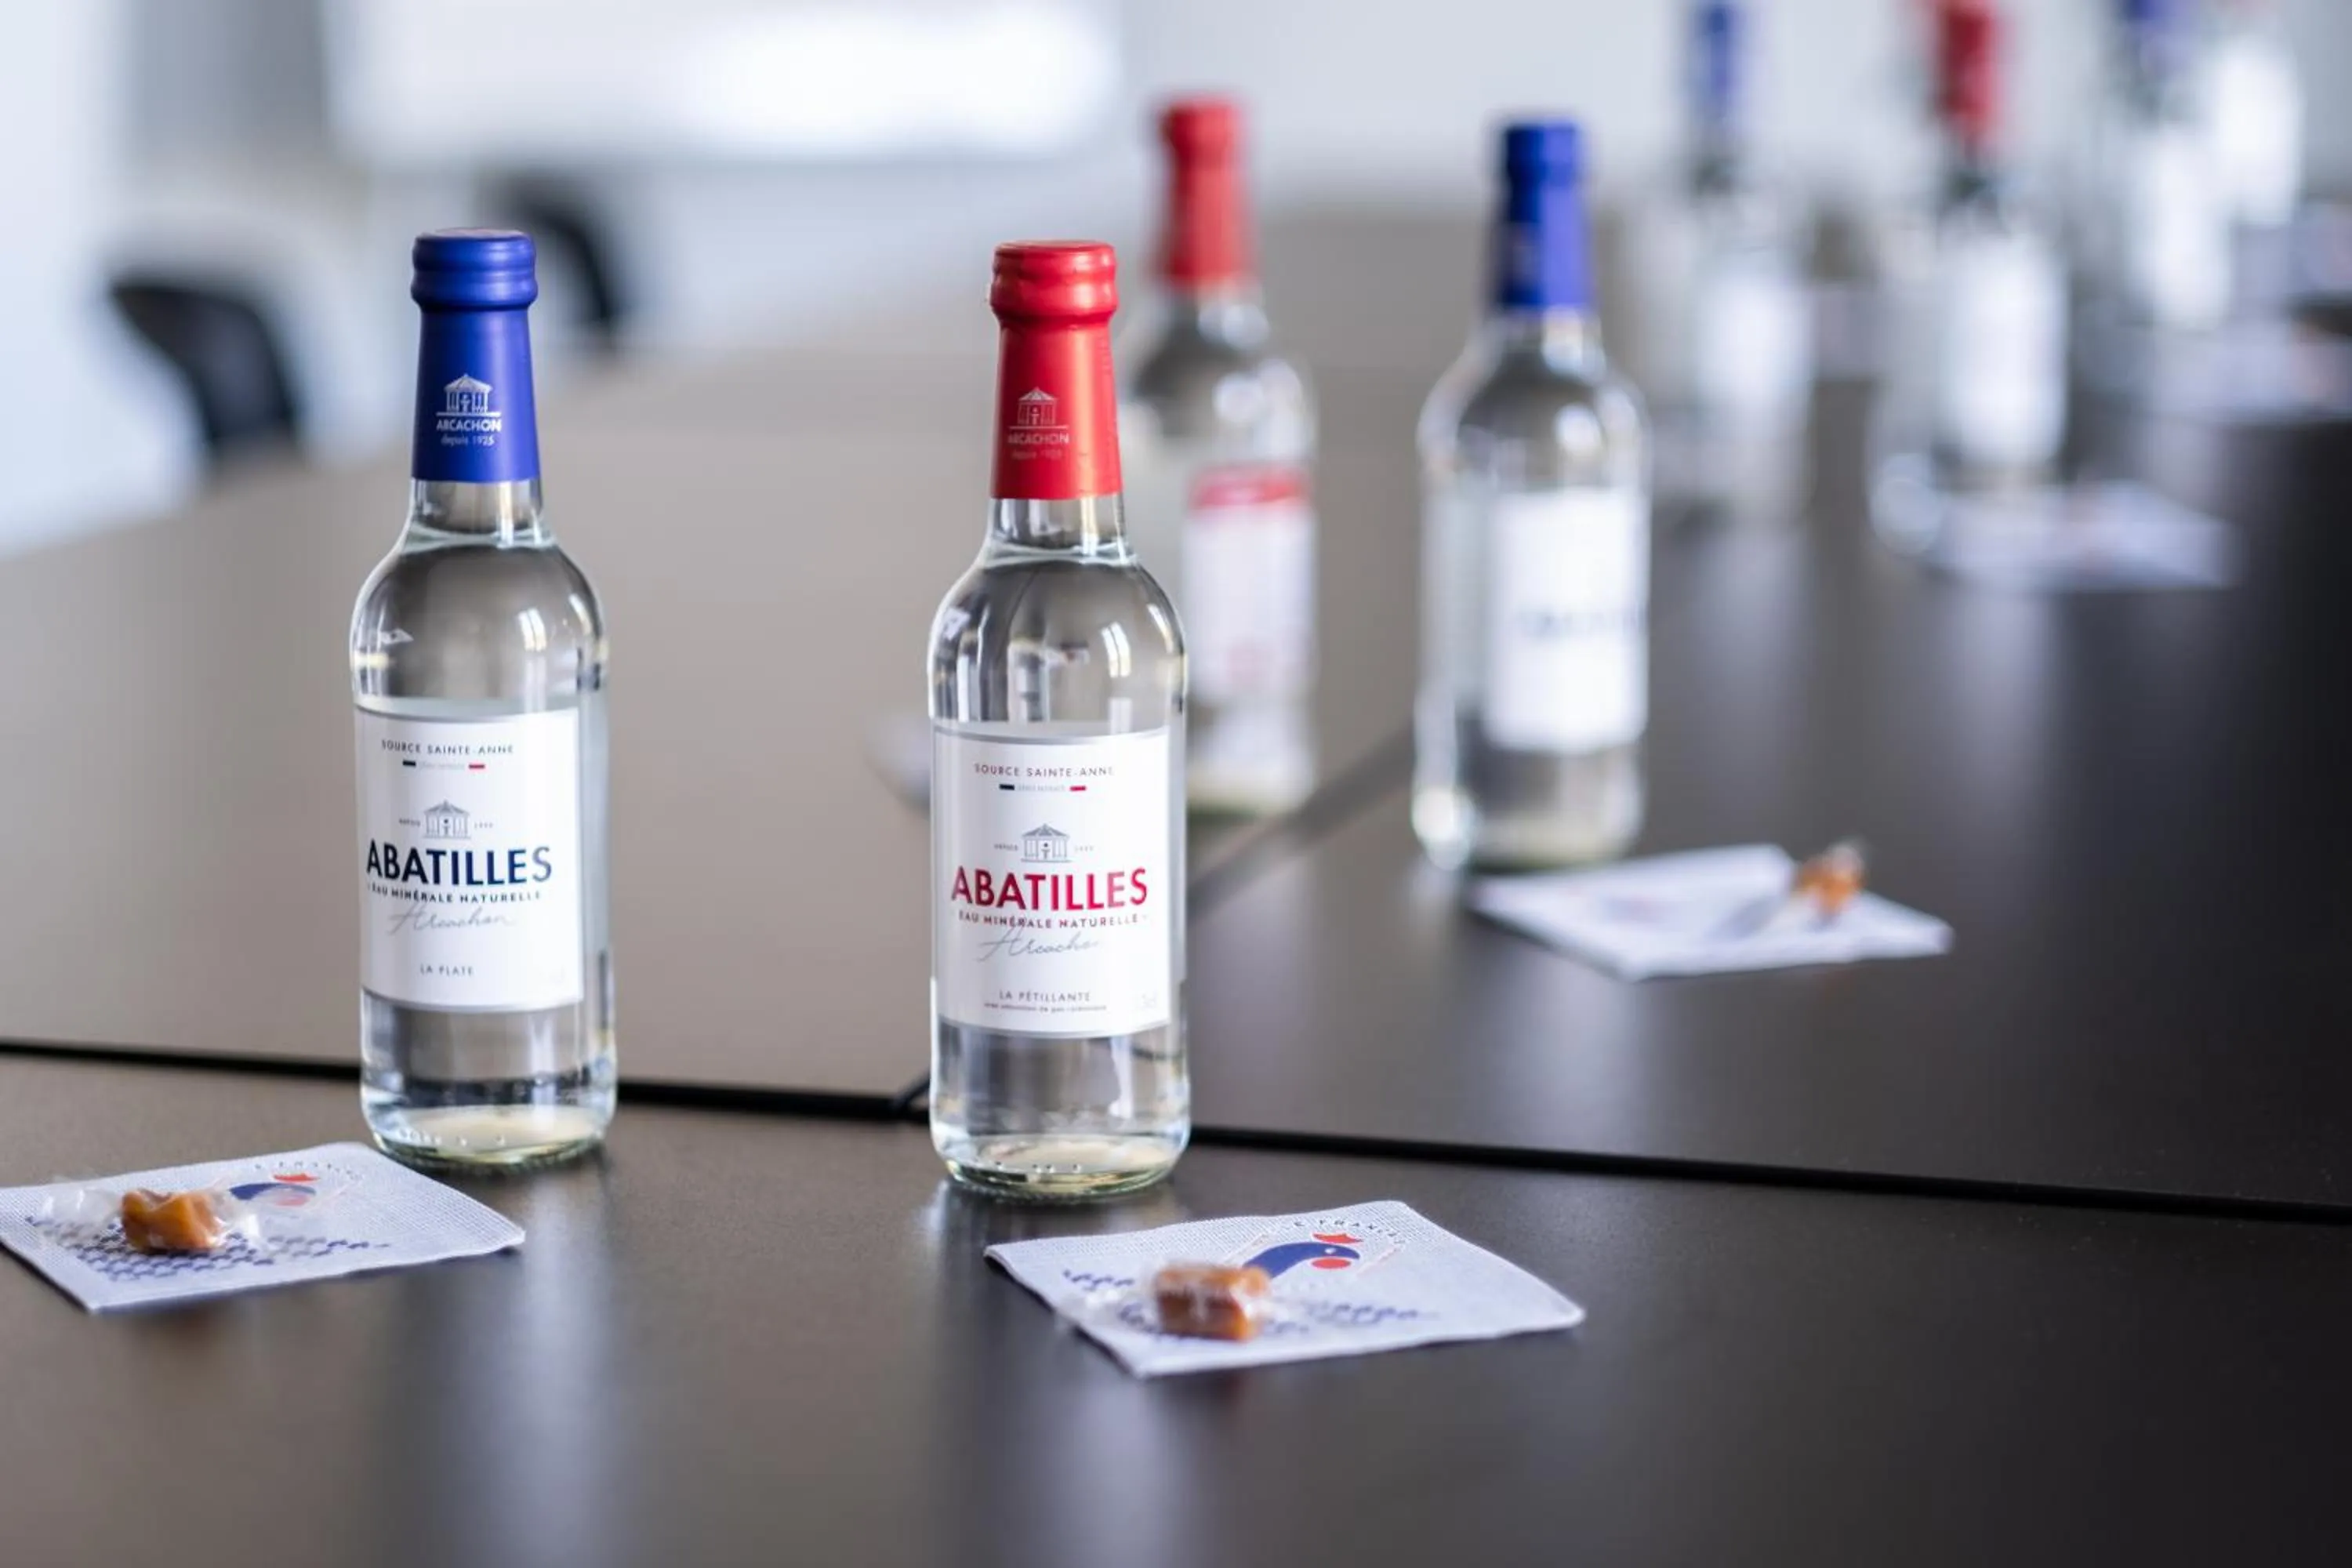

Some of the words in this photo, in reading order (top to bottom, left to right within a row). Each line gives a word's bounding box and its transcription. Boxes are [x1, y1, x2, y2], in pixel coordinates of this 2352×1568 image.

[436, 419, 502, 432] ARCACHON
[381, 739, 421, 753] SOURCE
[974, 764, 1019, 776] SOURCE
[366, 838, 553, 887] ABATILLES
[372, 883, 388, 896] EAU
[390, 887, 453, 903] MINÉRALE
[460, 891, 540, 903] NATURELLE
[950, 866, 1148, 911] ABATILLES
[958, 910, 979, 923] EAU
[982, 914, 1051, 929] MINÉRALE
[1058, 913, 1138, 928] NATURELLE
[999, 989, 1013, 1000] LA
